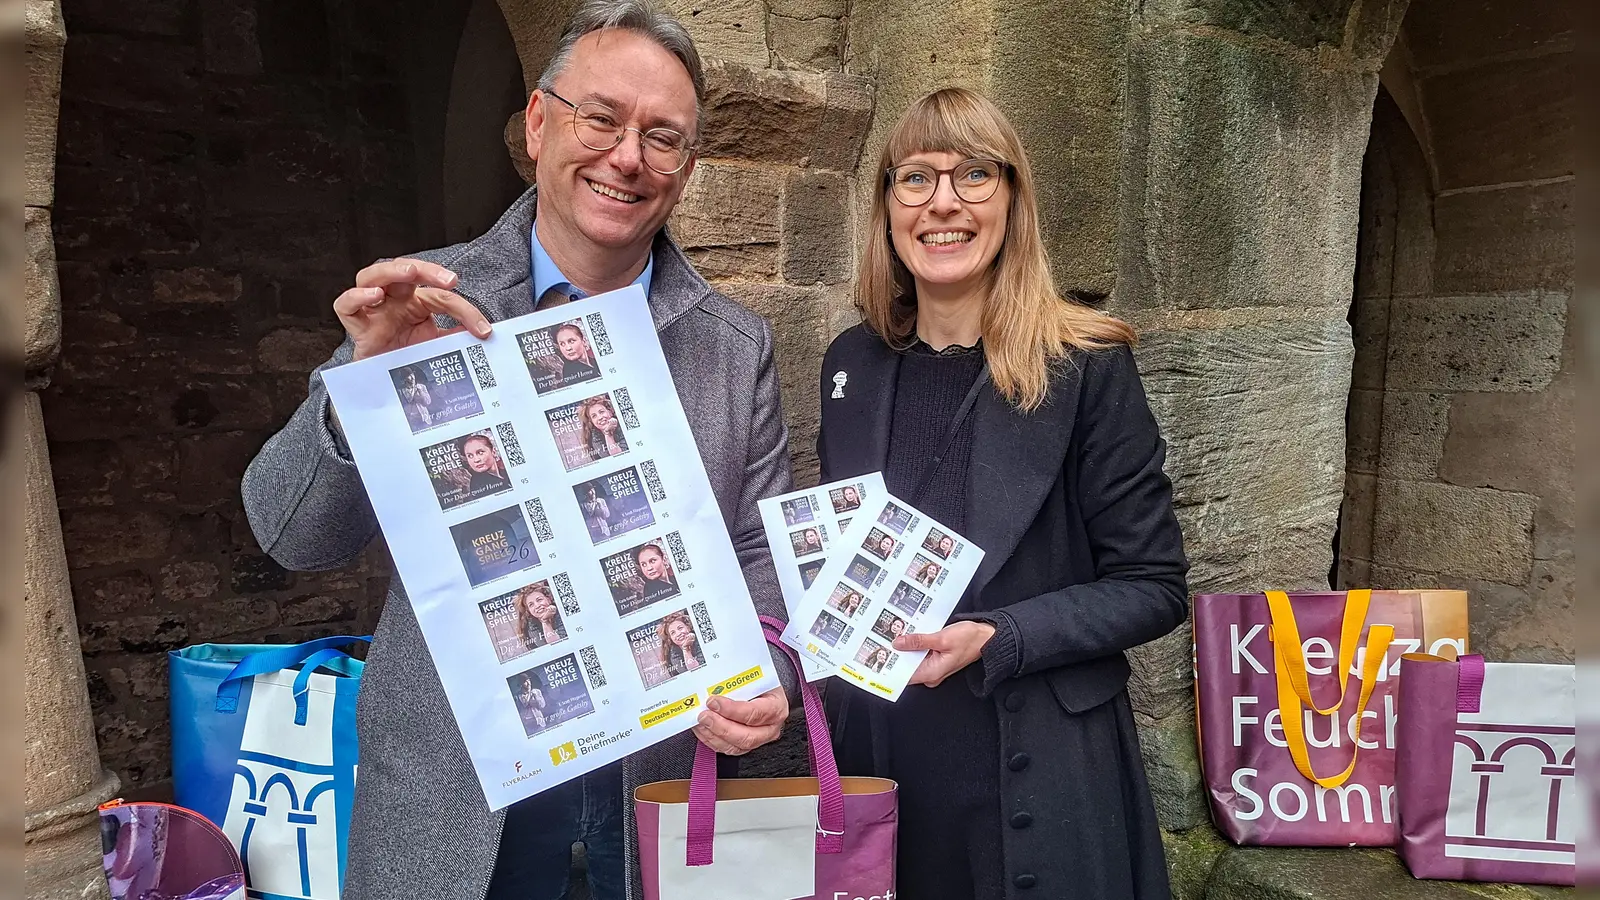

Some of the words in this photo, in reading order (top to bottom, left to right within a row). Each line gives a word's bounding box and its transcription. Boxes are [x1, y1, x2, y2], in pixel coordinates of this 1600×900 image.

[521, 332, 550, 344] KREUZ
[524, 339, 552, 352] GANG
[528, 347, 556, 360] SPIELE
[429, 355, 460, 370] KREUZ
[433, 364, 462, 378] GANG
[436, 371, 466, 385] SPIELE
[549, 407, 577, 420] KREUZ
[552, 415, 579, 427] GANG
[555, 423, 582, 435] SPIELE
[426, 443, 456, 458] KREUZ
[429, 452, 459, 466] GANG
[432, 460, 462, 474] SPIELE
[607, 470, 634, 485] KREUZ
[610, 478, 636, 492] GANG
[613, 486, 640, 500] SPIELE
[472, 530, 505, 547] KREUZ
[476, 539, 508, 556] GANG
[605, 553, 632, 568] KREUZ
[608, 561, 634, 575] GANG
[611, 569, 637, 583] SPIELE
[483, 597, 513, 612] KREUZ
[487, 605, 515, 620] GANG
[489, 613, 518, 628] SPIELE
[630, 626, 657, 641] KREUZ
[633, 634, 659, 648] GANG
[635, 641, 661, 655] SPIELE
[544, 658, 573, 674] KREUZ
[548, 666, 575, 680] GANG
[550, 674, 578, 689] SPIELE
[726, 670, 759, 689] GoGreen
[640, 700, 662, 713] Powered
[645, 711, 670, 725] Deutsche
[671, 705, 683, 714] Post
[577, 730, 606, 746] Deine
[502, 768, 542, 788] FLYERALARM
